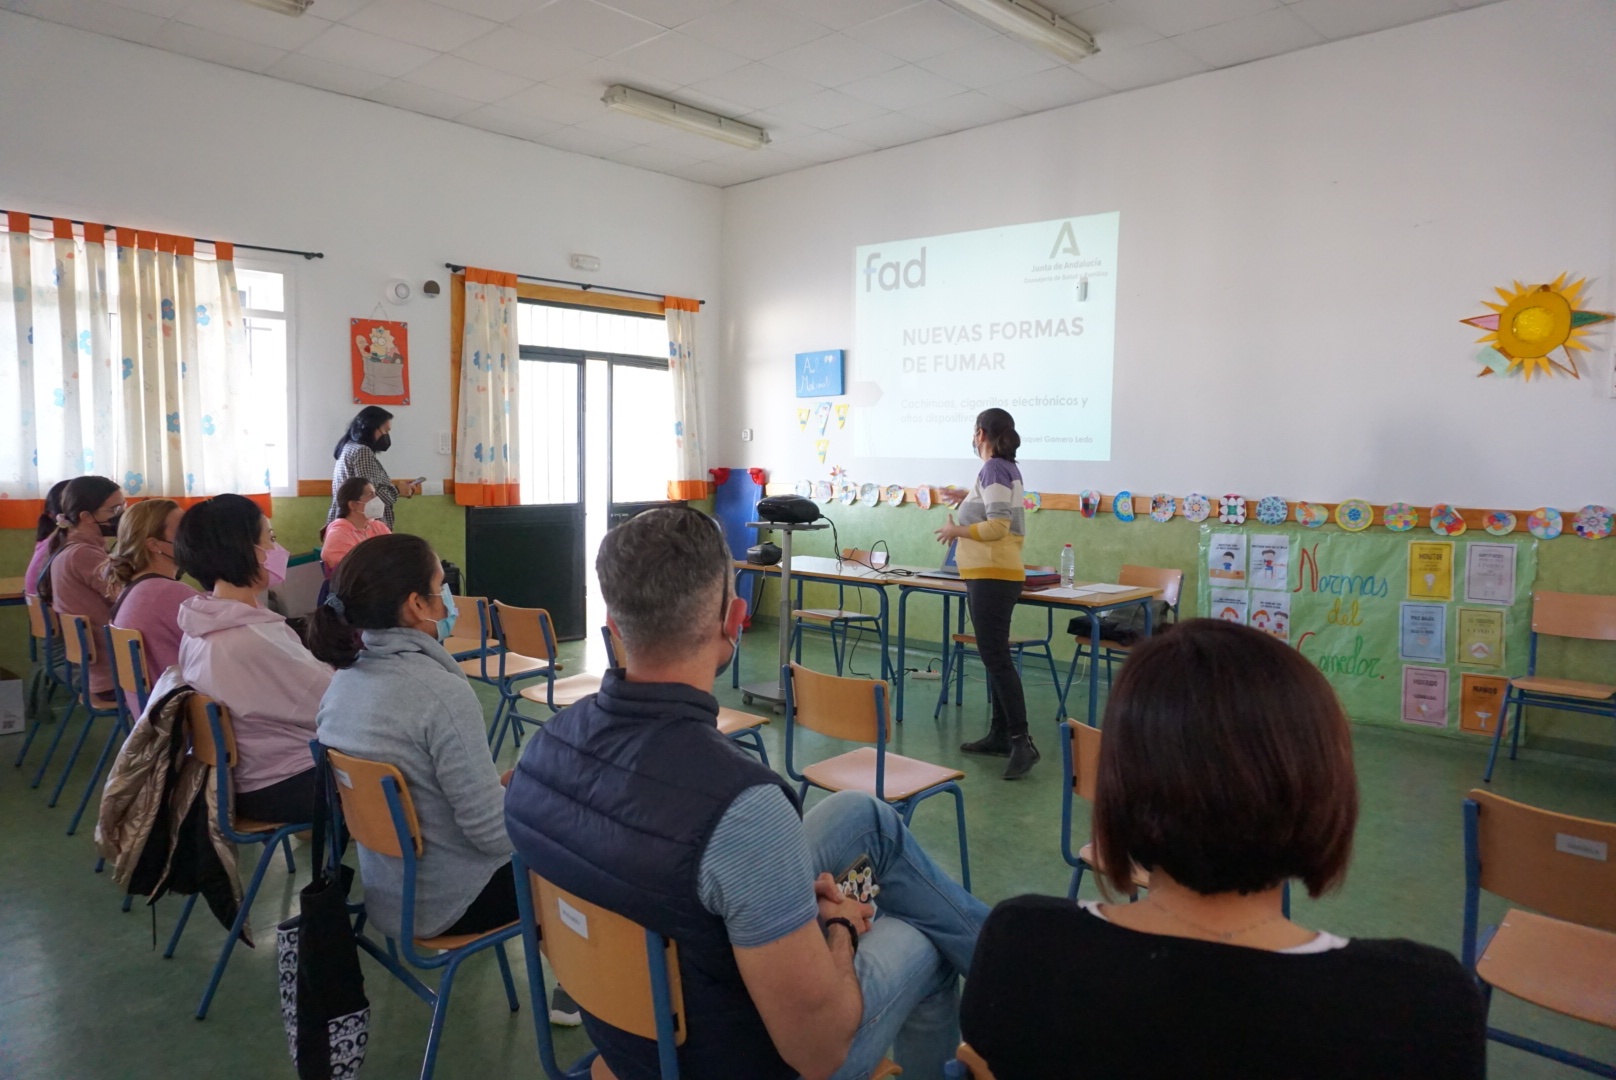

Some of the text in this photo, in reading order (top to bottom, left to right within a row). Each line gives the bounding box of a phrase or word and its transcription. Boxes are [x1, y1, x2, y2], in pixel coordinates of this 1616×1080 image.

[863, 246, 926, 292] fad
[1031, 257, 1102, 272] Junta de Andalucía
[903, 317, 1084, 346] NUEVAS FORMAS
[903, 352, 1005, 373] DE FUMAR
[960, 397, 1008, 410] cigarrillos
[1012, 395, 1078, 407] electrónicos
[1081, 397, 1088, 408] y
[901, 411, 977, 424] otros dispositivo
[1044, 435, 1073, 443] Gamero
[1075, 435, 1093, 444] Ledo
[1293, 543, 1388, 598] Normas
[1327, 599, 1363, 627] del
